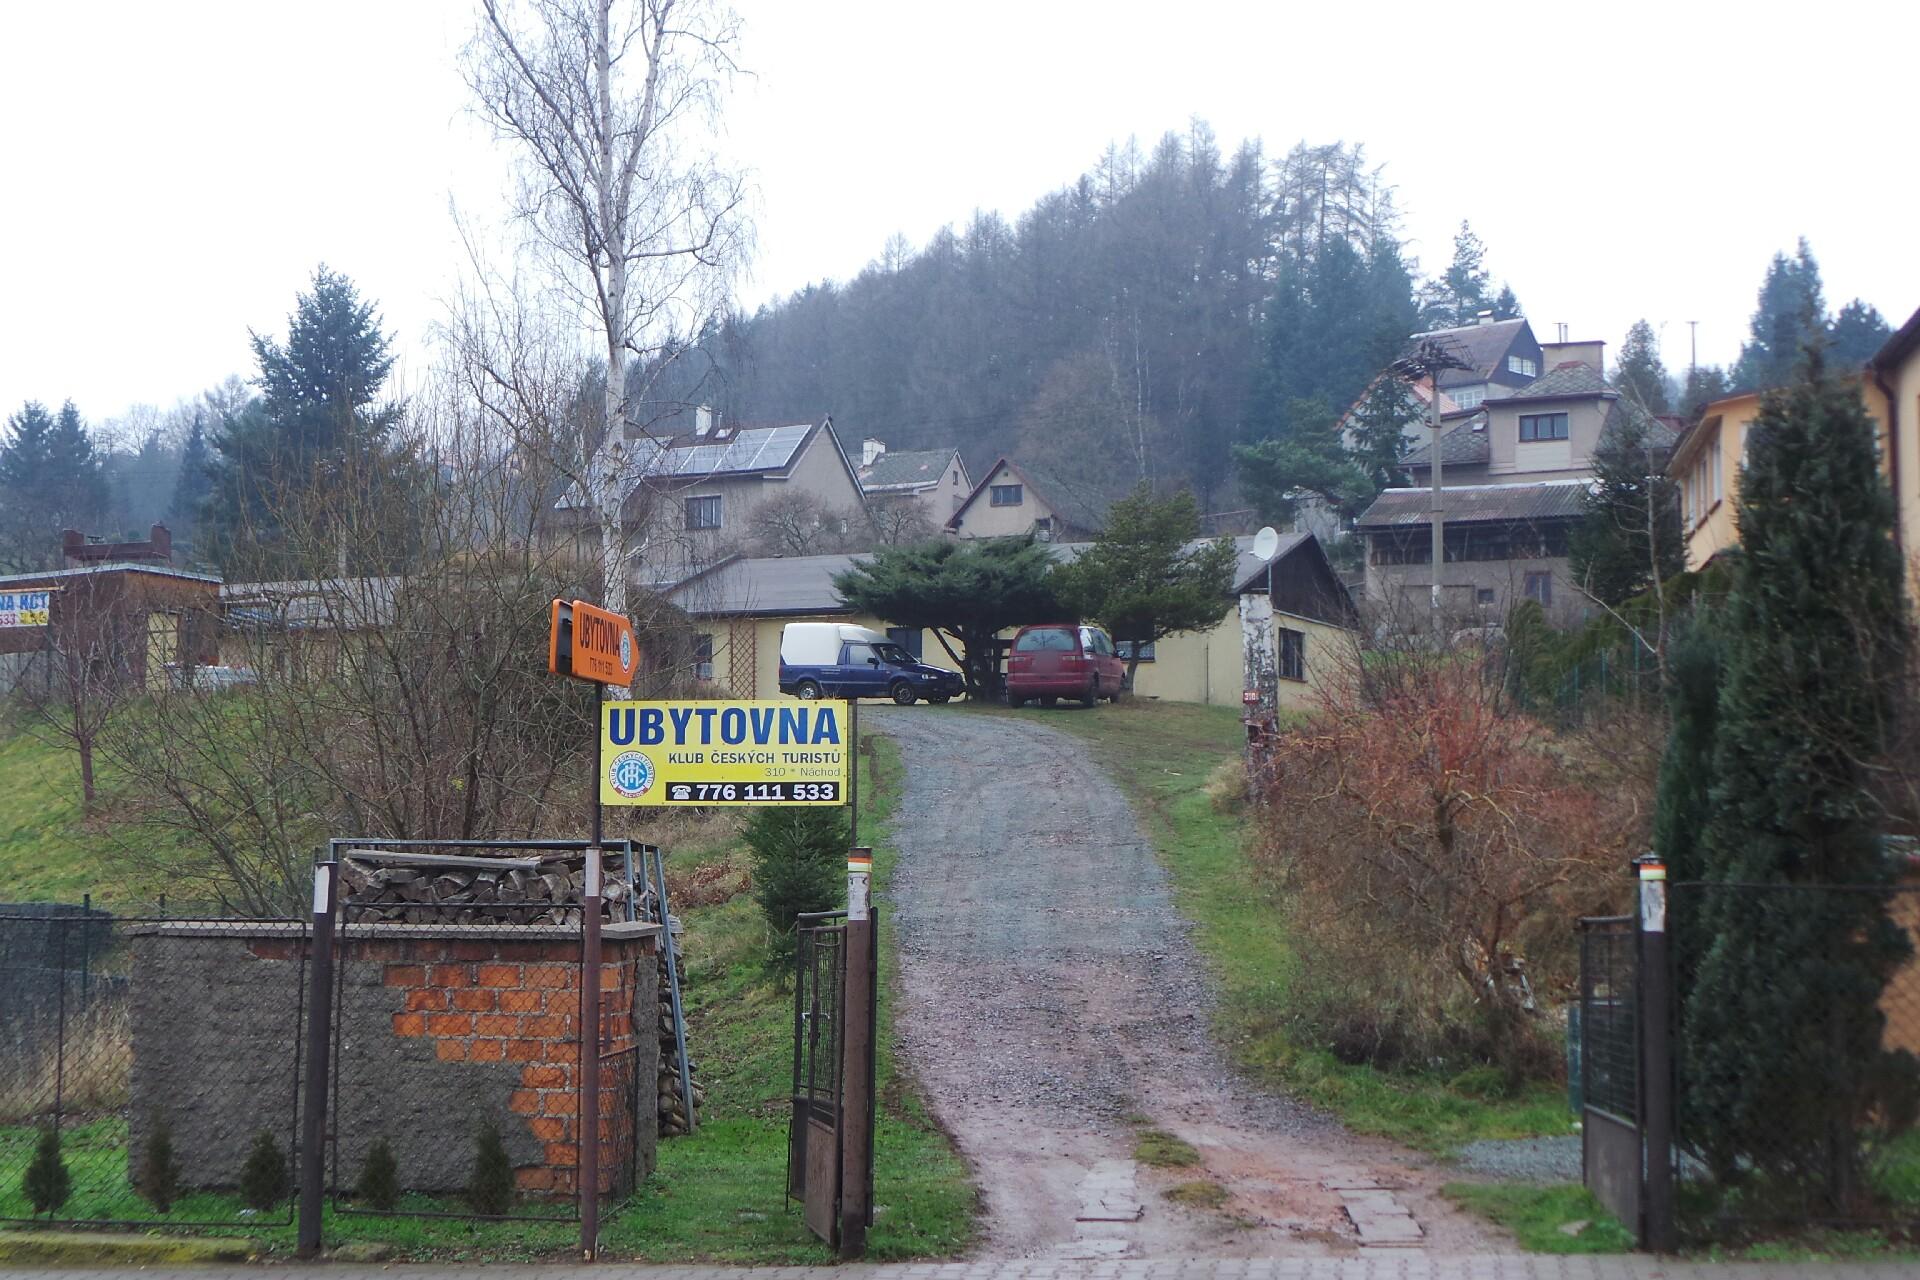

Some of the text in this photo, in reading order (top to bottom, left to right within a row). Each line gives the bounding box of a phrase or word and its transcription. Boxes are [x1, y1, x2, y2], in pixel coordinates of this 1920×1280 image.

[579, 612, 621, 657] UBYTOVNA
[609, 707, 840, 745] UBYTOVNA
[668, 752, 704, 764] KLUB
[711, 750, 775, 764] ČESKÝCH
[764, 767, 841, 777] 310 Náchod
[696, 784, 834, 800] 776 111 533
